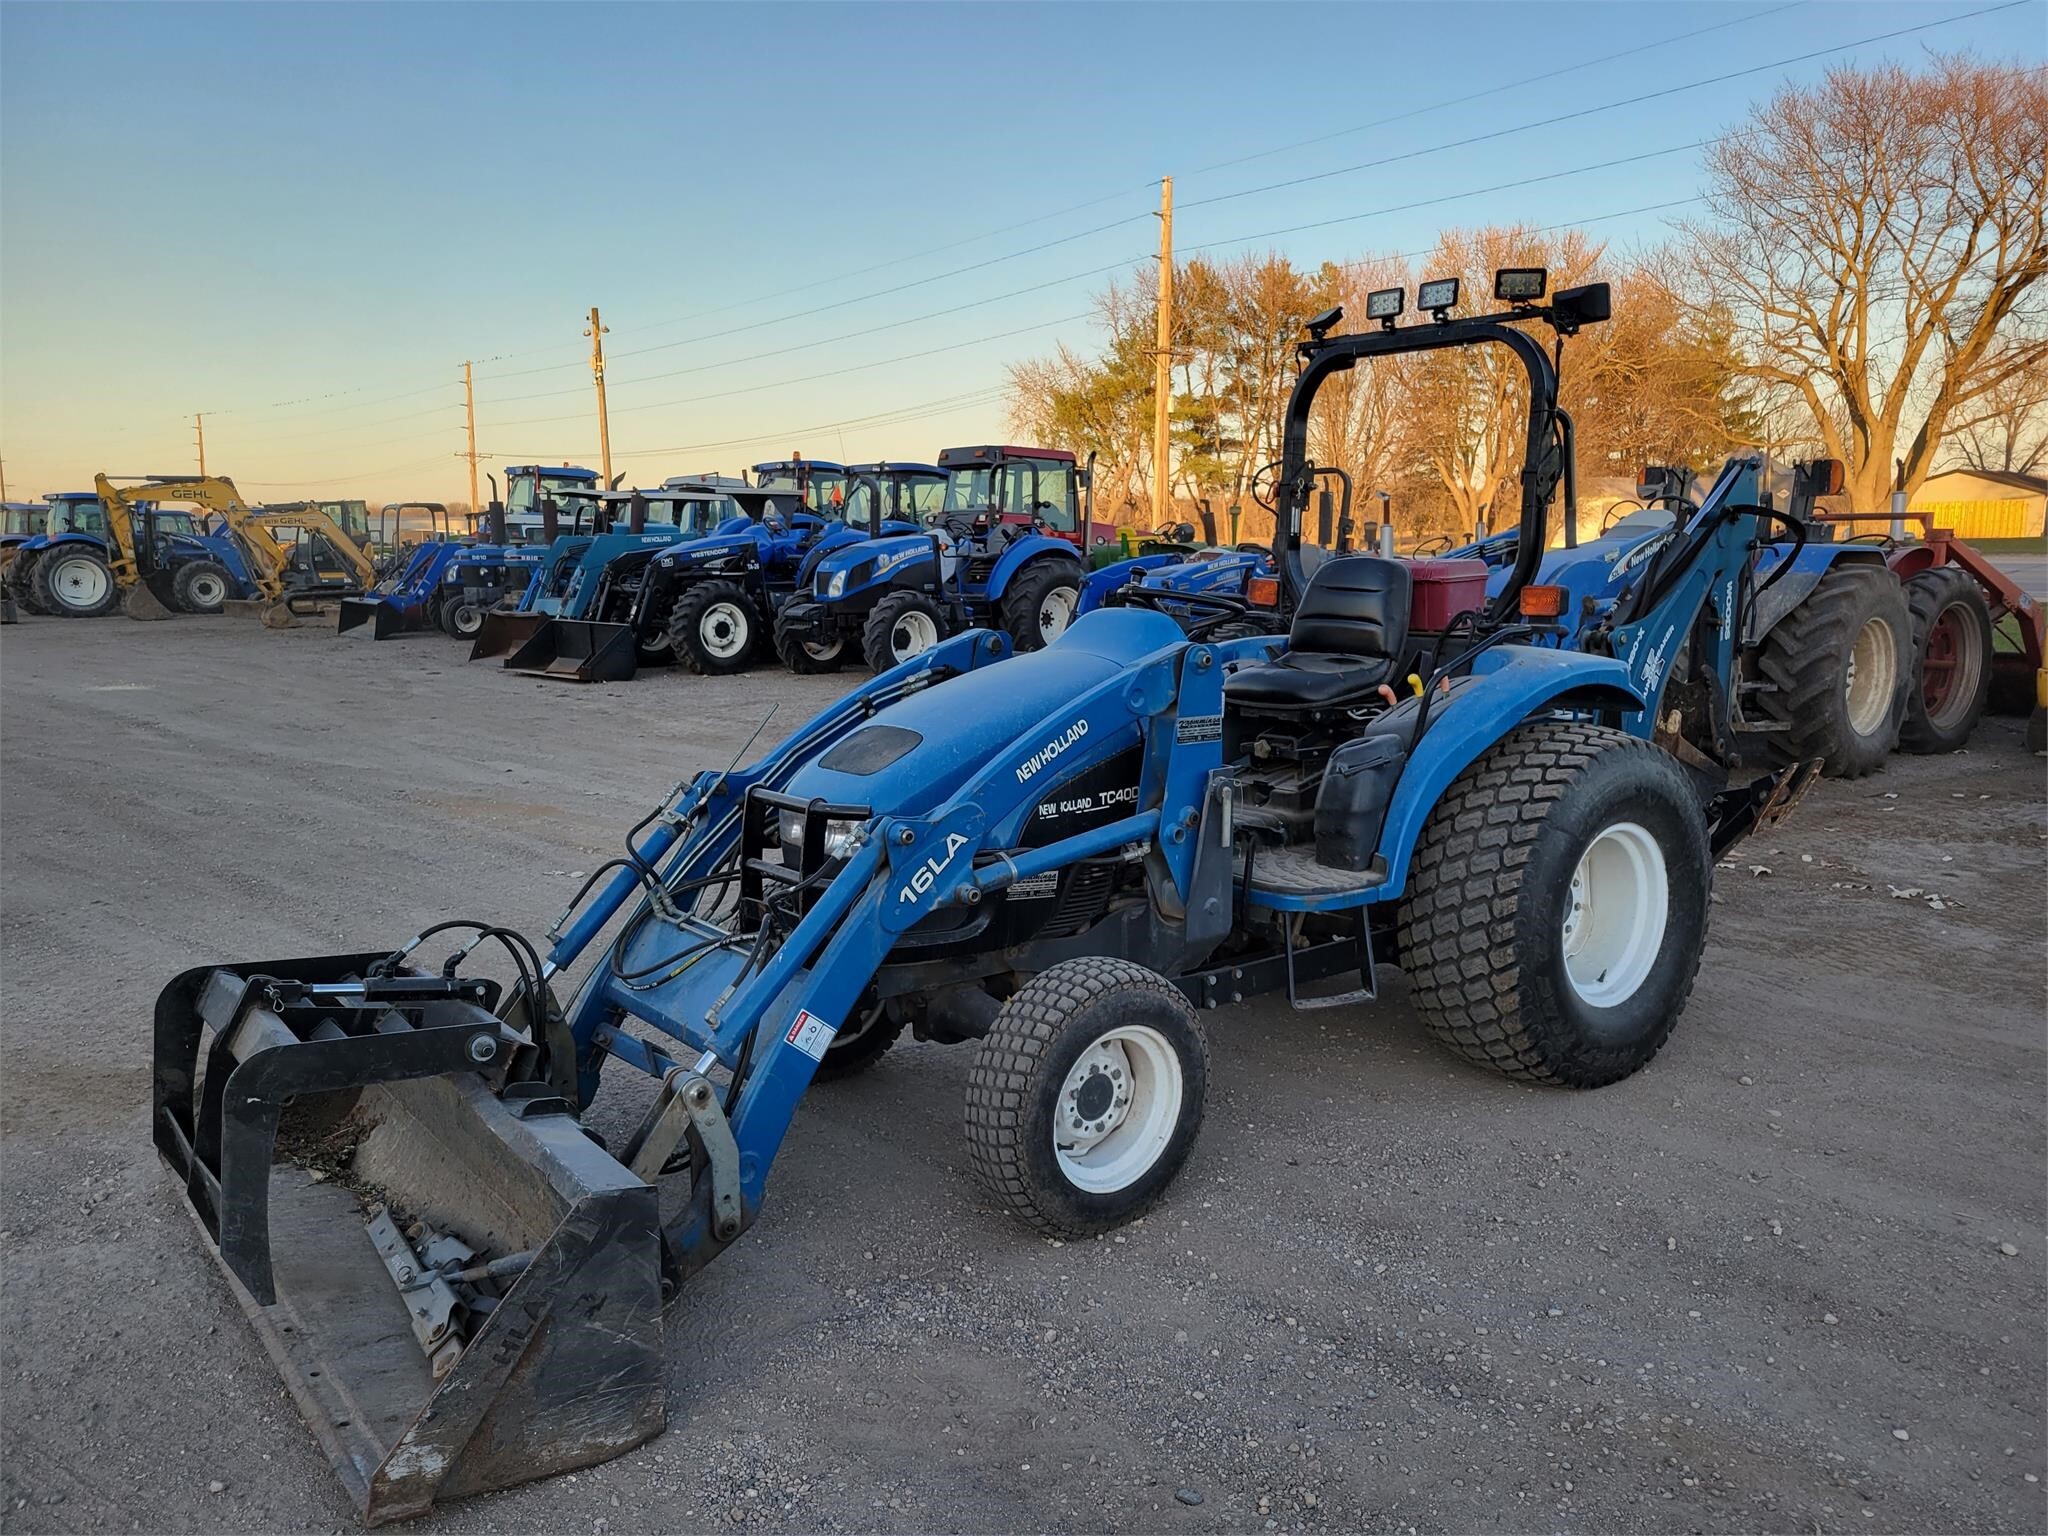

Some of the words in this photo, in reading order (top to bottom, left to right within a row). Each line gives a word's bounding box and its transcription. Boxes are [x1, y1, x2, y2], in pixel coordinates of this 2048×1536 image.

[171, 489, 213, 499] GEHL
[280, 517, 308, 525] GEHL
[652, 535, 672, 543] HOLLAND
[690, 547, 729, 559] WESTENDORF
[891, 552, 905, 562] NEW
[905, 545, 930, 557] HOLLAND
[1221, 557, 1240, 568] HOLLAND
[1631, 553, 1645, 568] New
[1724, 580, 1734, 641] WOODS
[1015, 753, 1042, 784] NEW
[1039, 719, 1089, 766] HOLLAND
[1039, 802, 1057, 816] NEW
[900, 832, 969, 904] 16LA
[789, 1012, 806, 1036] DANGER
